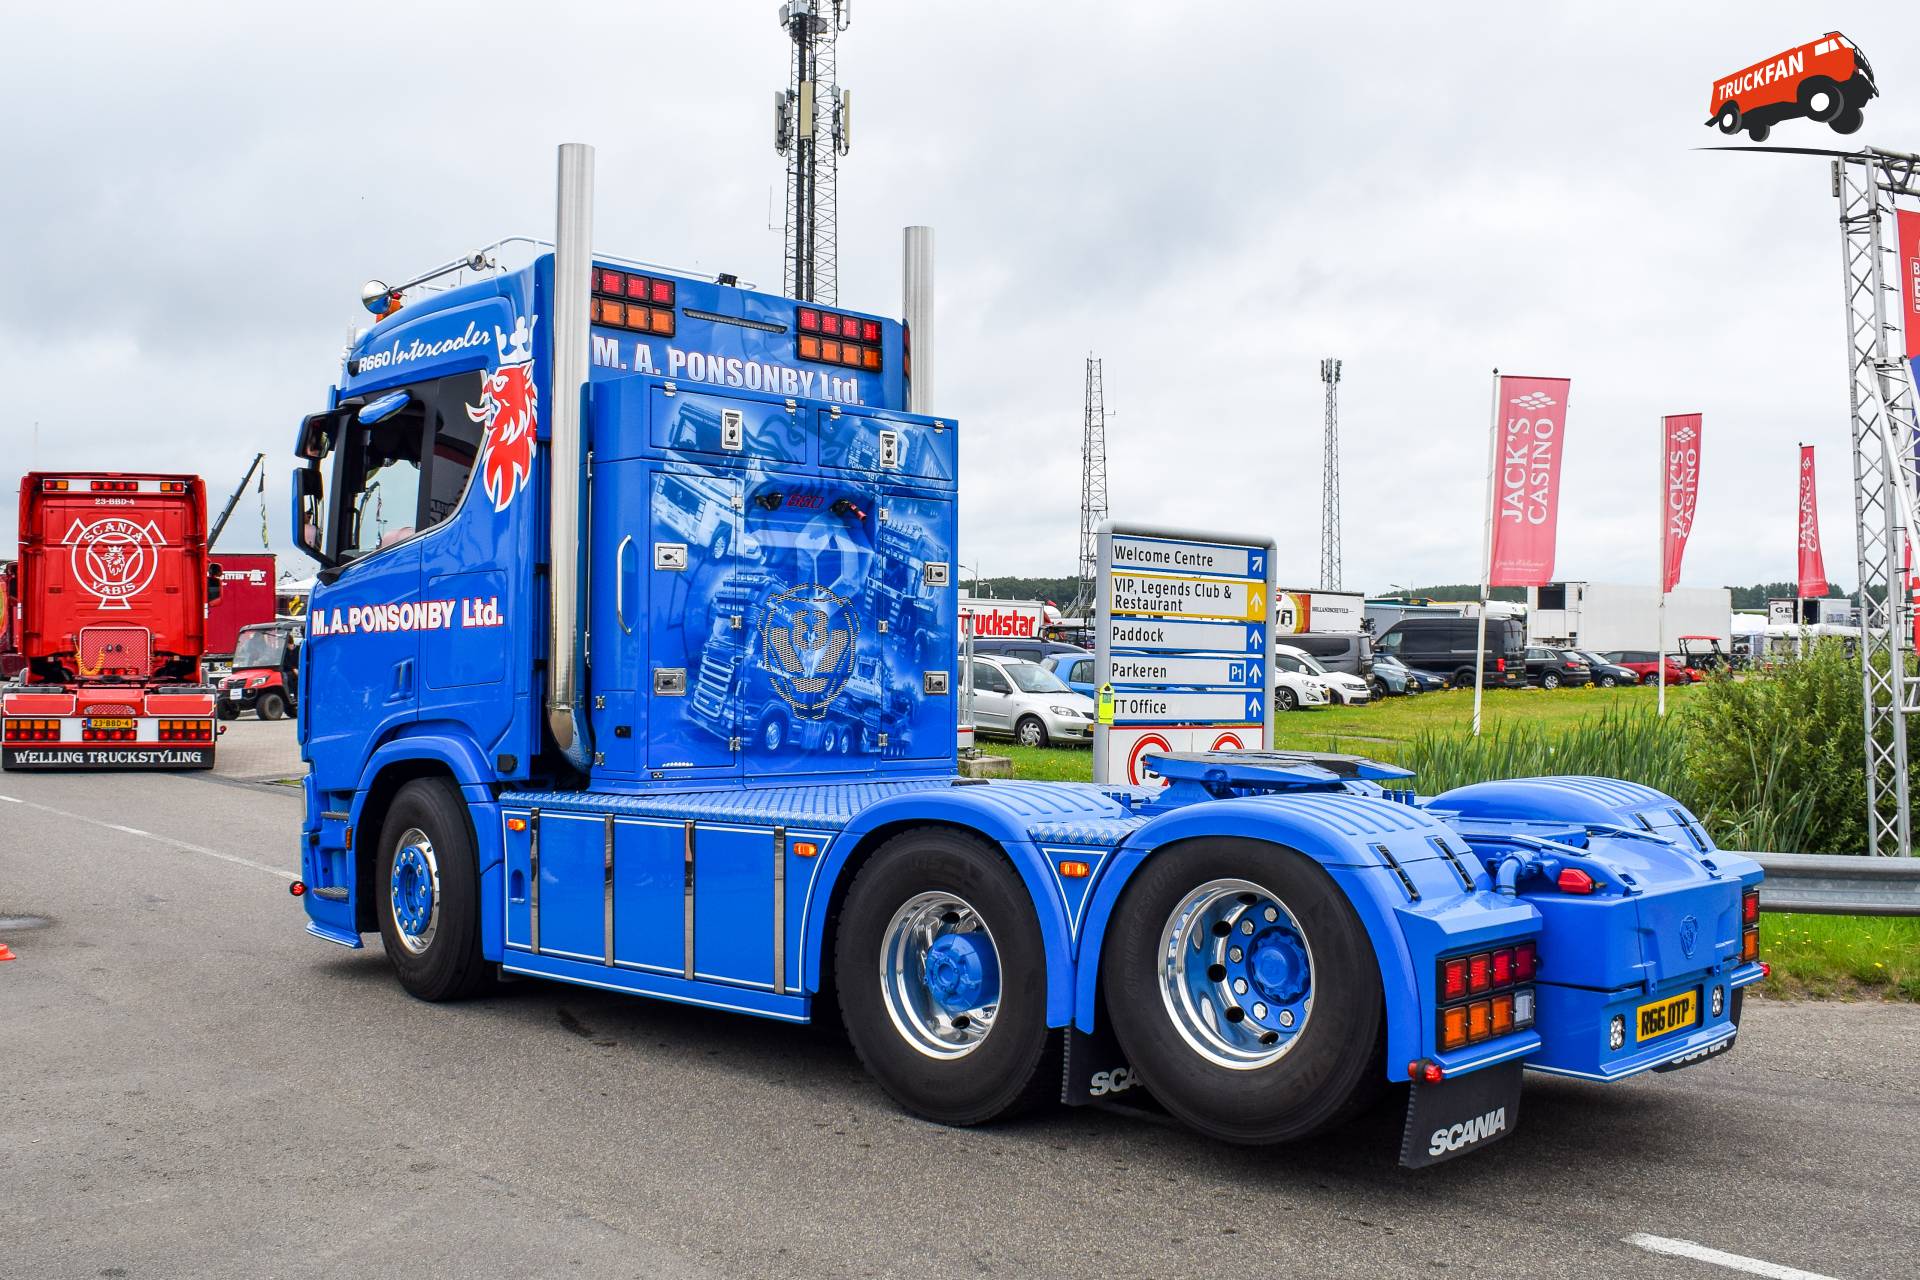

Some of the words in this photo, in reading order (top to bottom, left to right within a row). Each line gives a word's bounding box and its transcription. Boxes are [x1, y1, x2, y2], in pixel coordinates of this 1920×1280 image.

[358, 351, 391, 373] R660
[391, 320, 491, 366] Intercooler
[593, 336, 627, 370] M.
[634, 343, 661, 375] A.
[669, 349, 815, 398] PONSONBY
[820, 373, 865, 406] Ltd.
[1502, 417, 1530, 523] JACK'S
[1527, 418, 1554, 525] CASINO
[1669, 450, 1684, 539] JACK'S
[1681, 448, 1697, 538] CASINO
[84, 522, 143, 543] SCANIA
[1115, 545, 1170, 564] Welcome
[1174, 550, 1213, 567] Centre
[91, 580, 136, 595] VABIS
[1114, 578, 1137, 595] VIP,
[1141, 580, 1190, 598] Legends
[1194, 583, 1220, 598] Club
[1224, 585, 1232, 599] &
[462, 595, 504, 627] Ltd.
[1115, 594, 1183, 612] Restaurant
[1112, 626, 1164, 642] Paddock
[1112, 662, 1167, 678] Parkeren
[1231, 665, 1242, 680] P1
[1130, 699, 1167, 714] Office
[94, 719, 129, 727] 23-BBD-4
[14, 750, 84, 764] WELLING
[87, 750, 201, 764] TRUCKSTYLING
[1641, 1006, 1665, 1036] R66
[1667, 997, 1690, 1028] OTP
[1428, 1106, 1506, 1156] SCANIA
